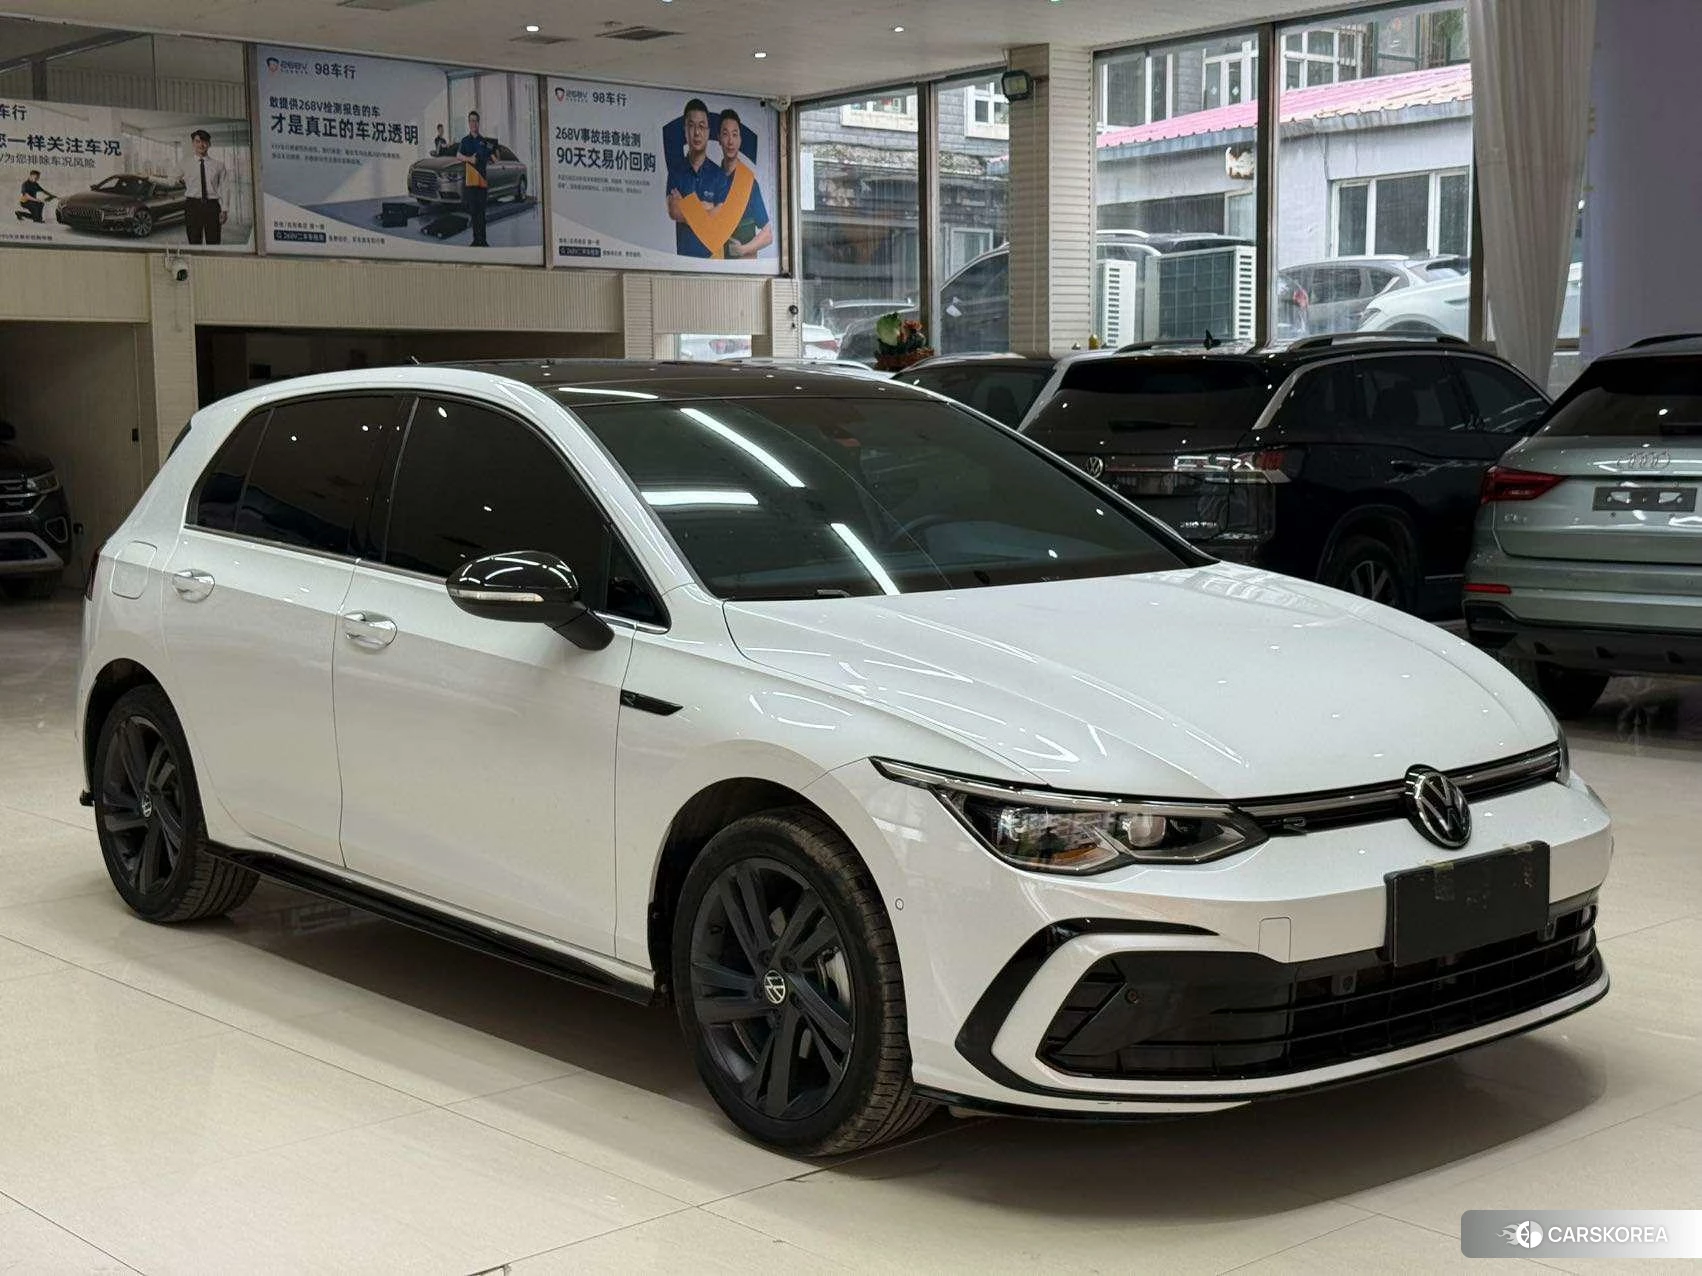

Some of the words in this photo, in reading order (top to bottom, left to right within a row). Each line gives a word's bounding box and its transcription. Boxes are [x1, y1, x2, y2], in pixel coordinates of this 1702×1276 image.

[314, 63, 356, 80] 98车行
[269, 95, 381, 117] 敢提供268V检测报告的车
[592, 91, 627, 107] 98车行
[270, 112, 419, 146] 才是真正的车况透明
[555, 126, 641, 148] 268V事故排查检测
[556, 146, 656, 173] 90天交易价回购
